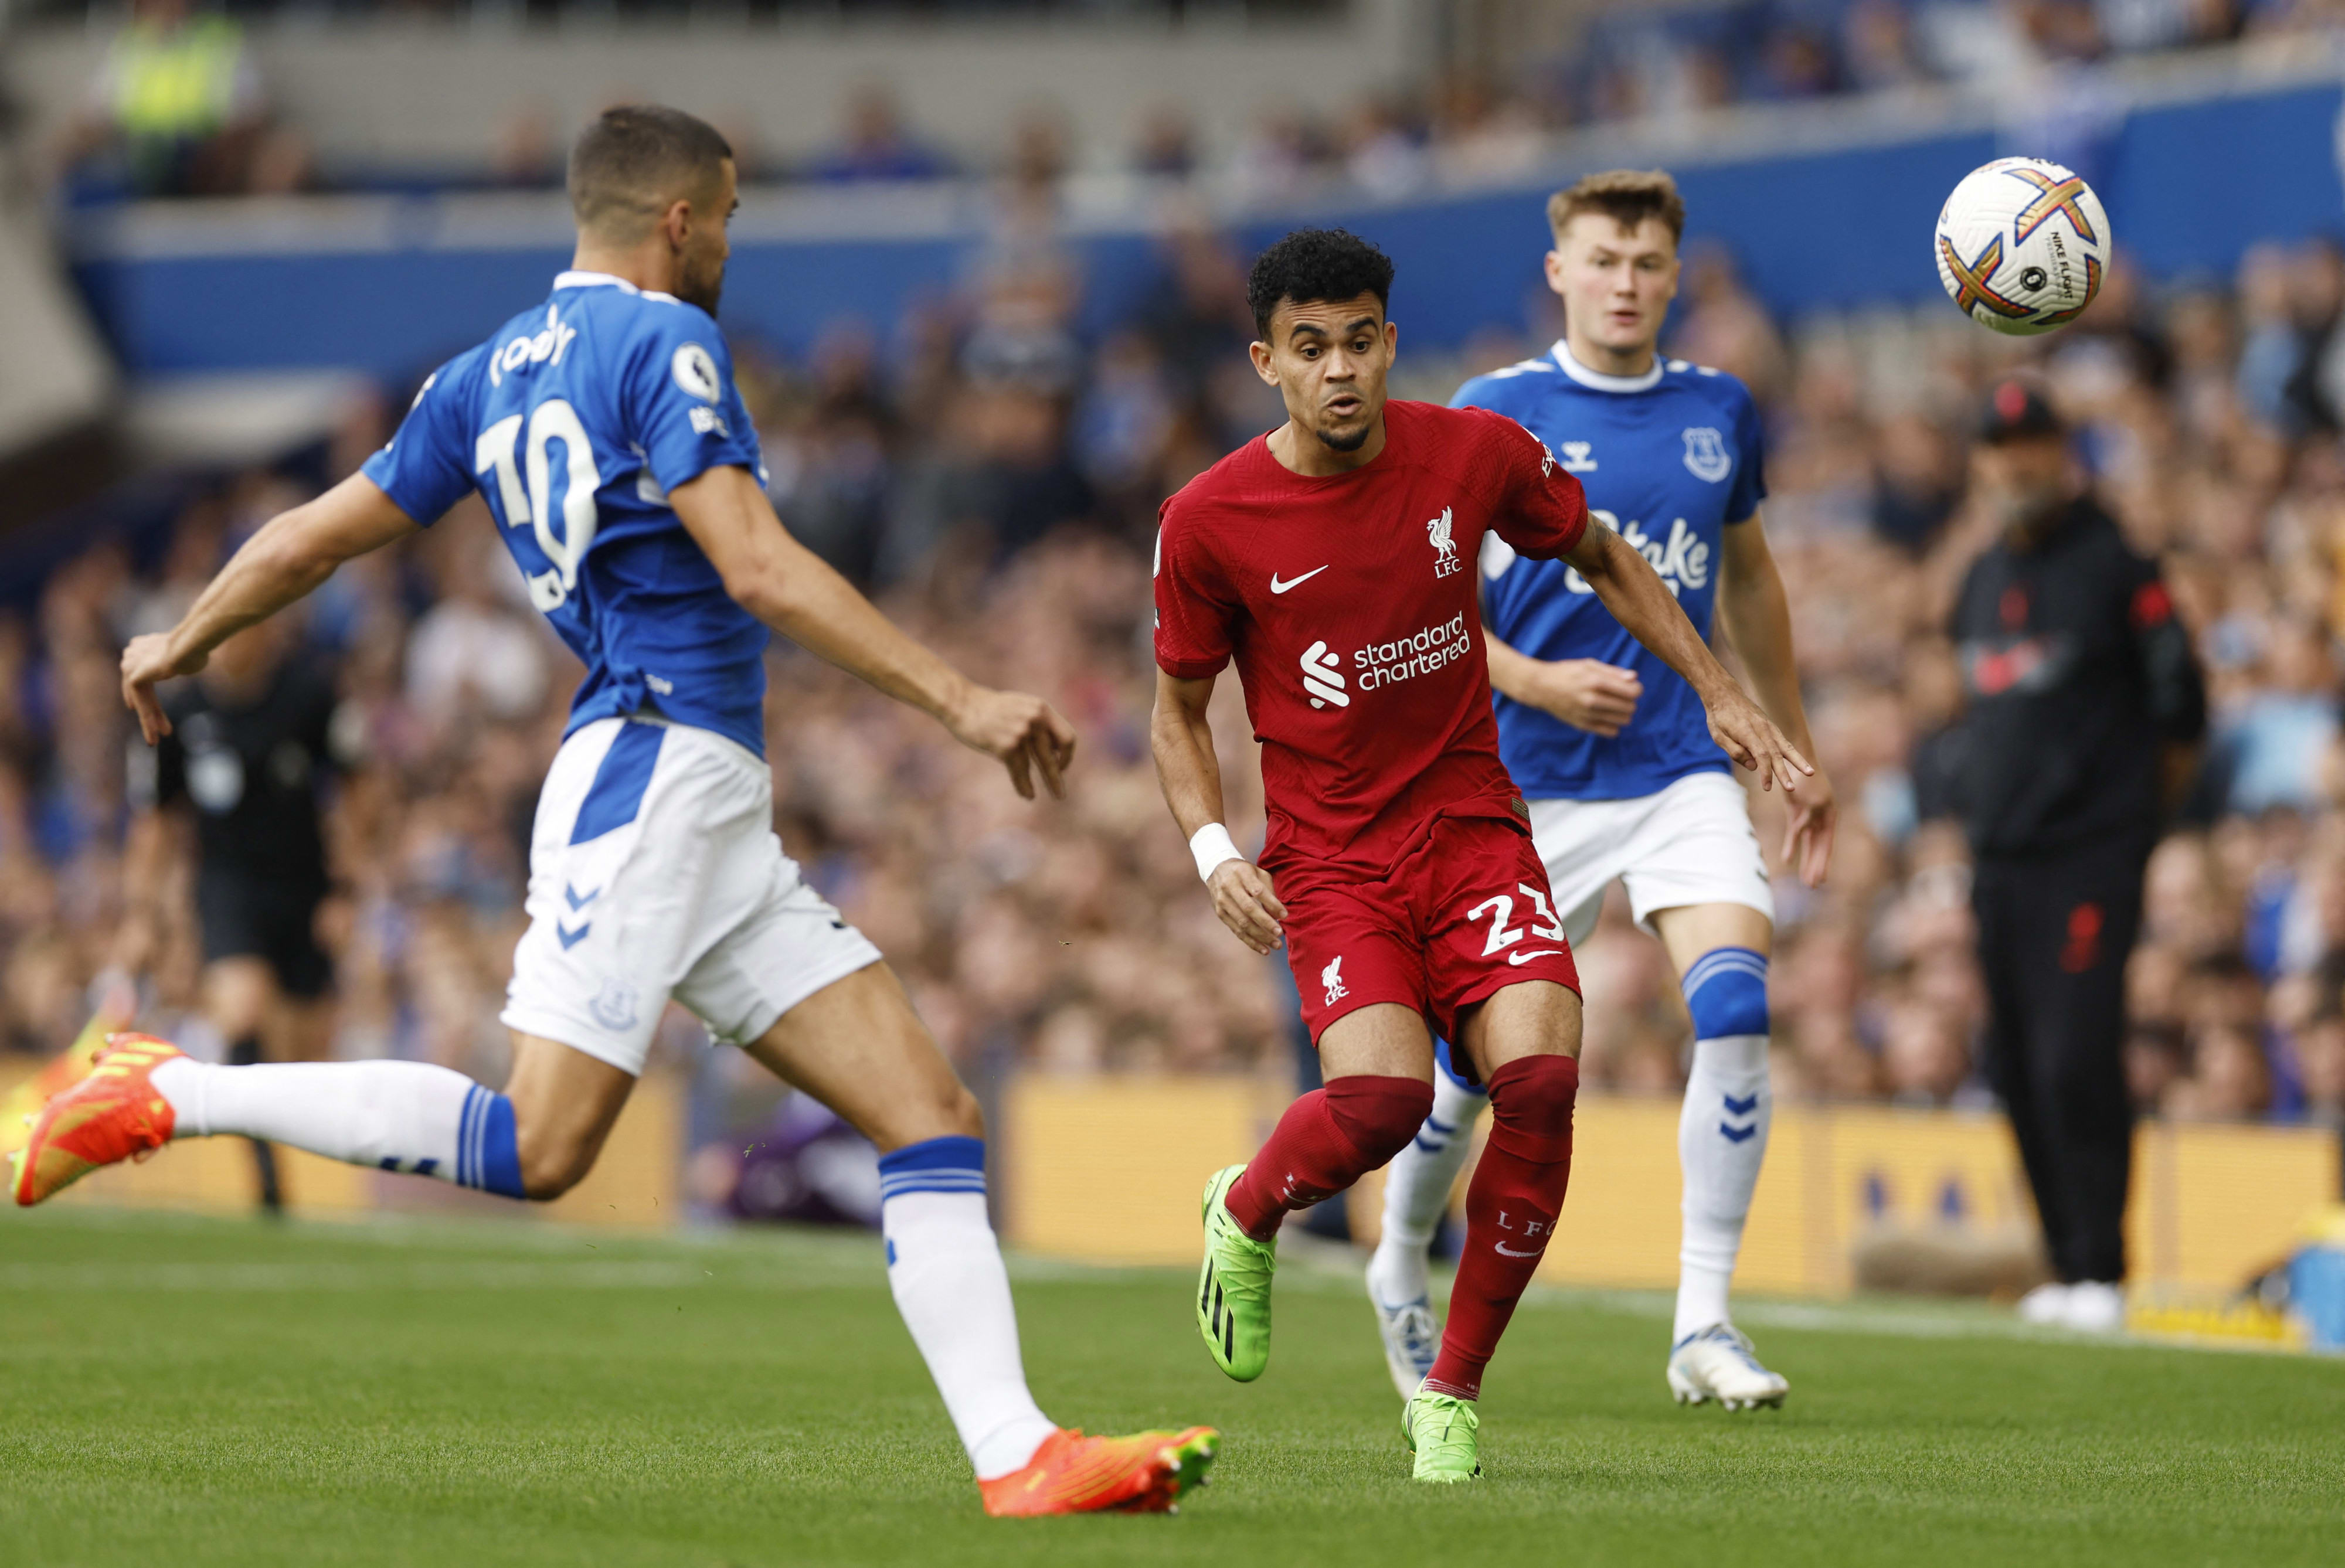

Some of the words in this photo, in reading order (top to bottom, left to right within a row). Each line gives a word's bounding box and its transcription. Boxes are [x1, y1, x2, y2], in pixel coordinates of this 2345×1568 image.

[2050, 232, 2066, 259] NIKE
[2059, 261, 2074, 298] FLIGHT
[1354, 610, 1463, 669] standard
[1358, 629, 1470, 691] chartered
[1467, 883, 1565, 957] 23
